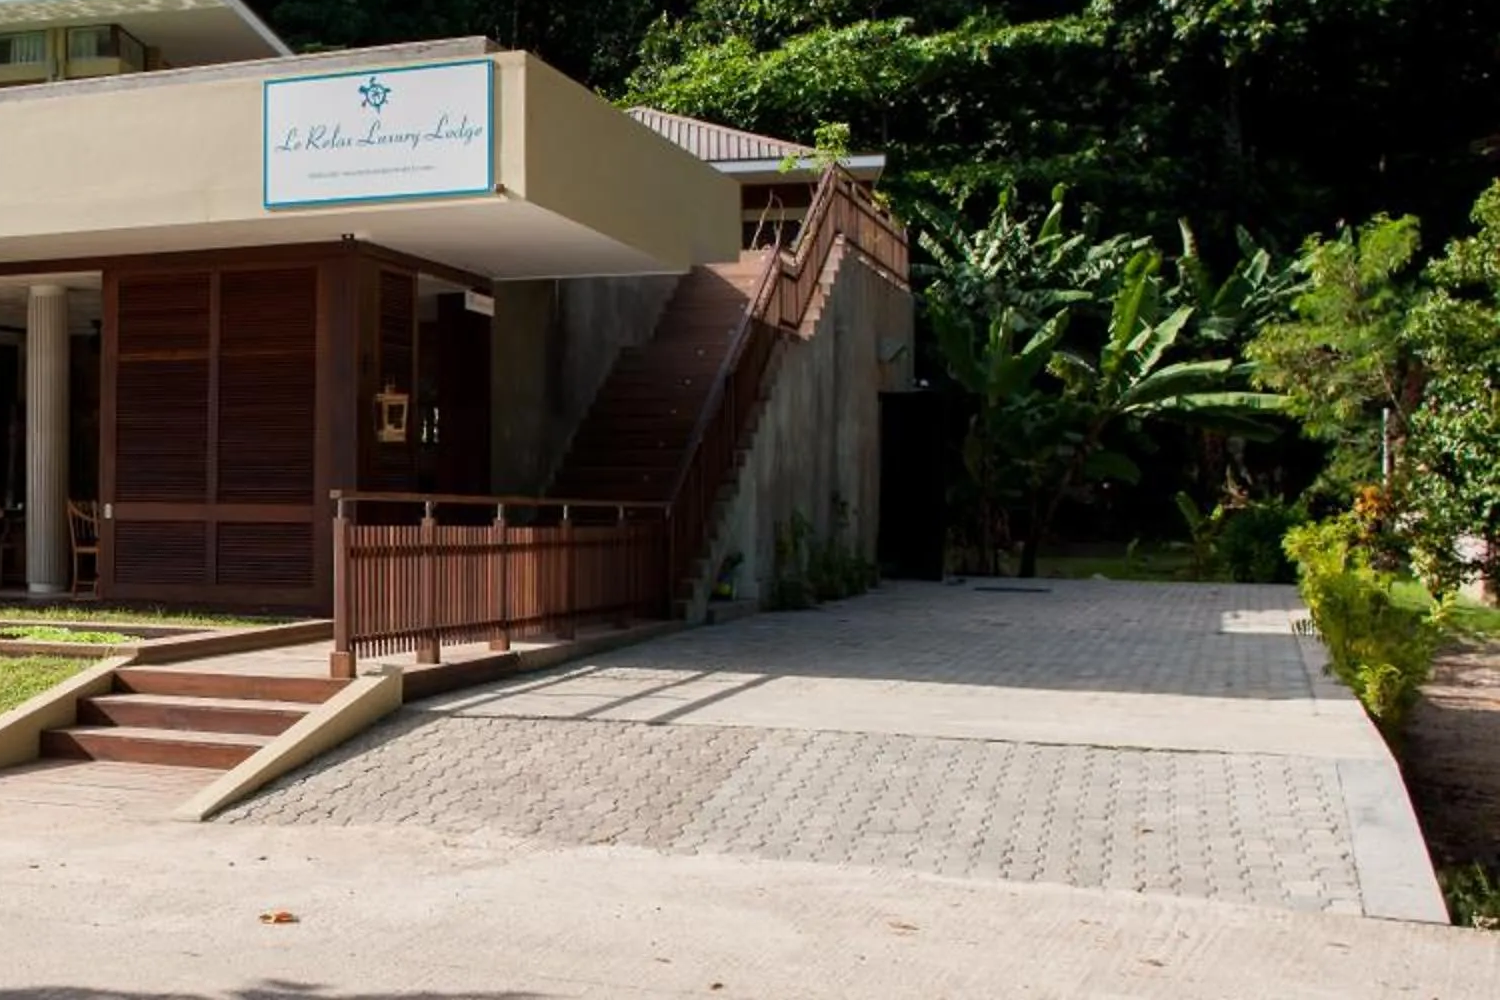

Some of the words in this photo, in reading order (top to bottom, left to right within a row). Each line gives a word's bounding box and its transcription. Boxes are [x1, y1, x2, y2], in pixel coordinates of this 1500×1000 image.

[275, 125, 301, 151] Le
[304, 122, 352, 150] Relax
[358, 119, 421, 149] Luxury
[425, 114, 483, 145] Lodge
